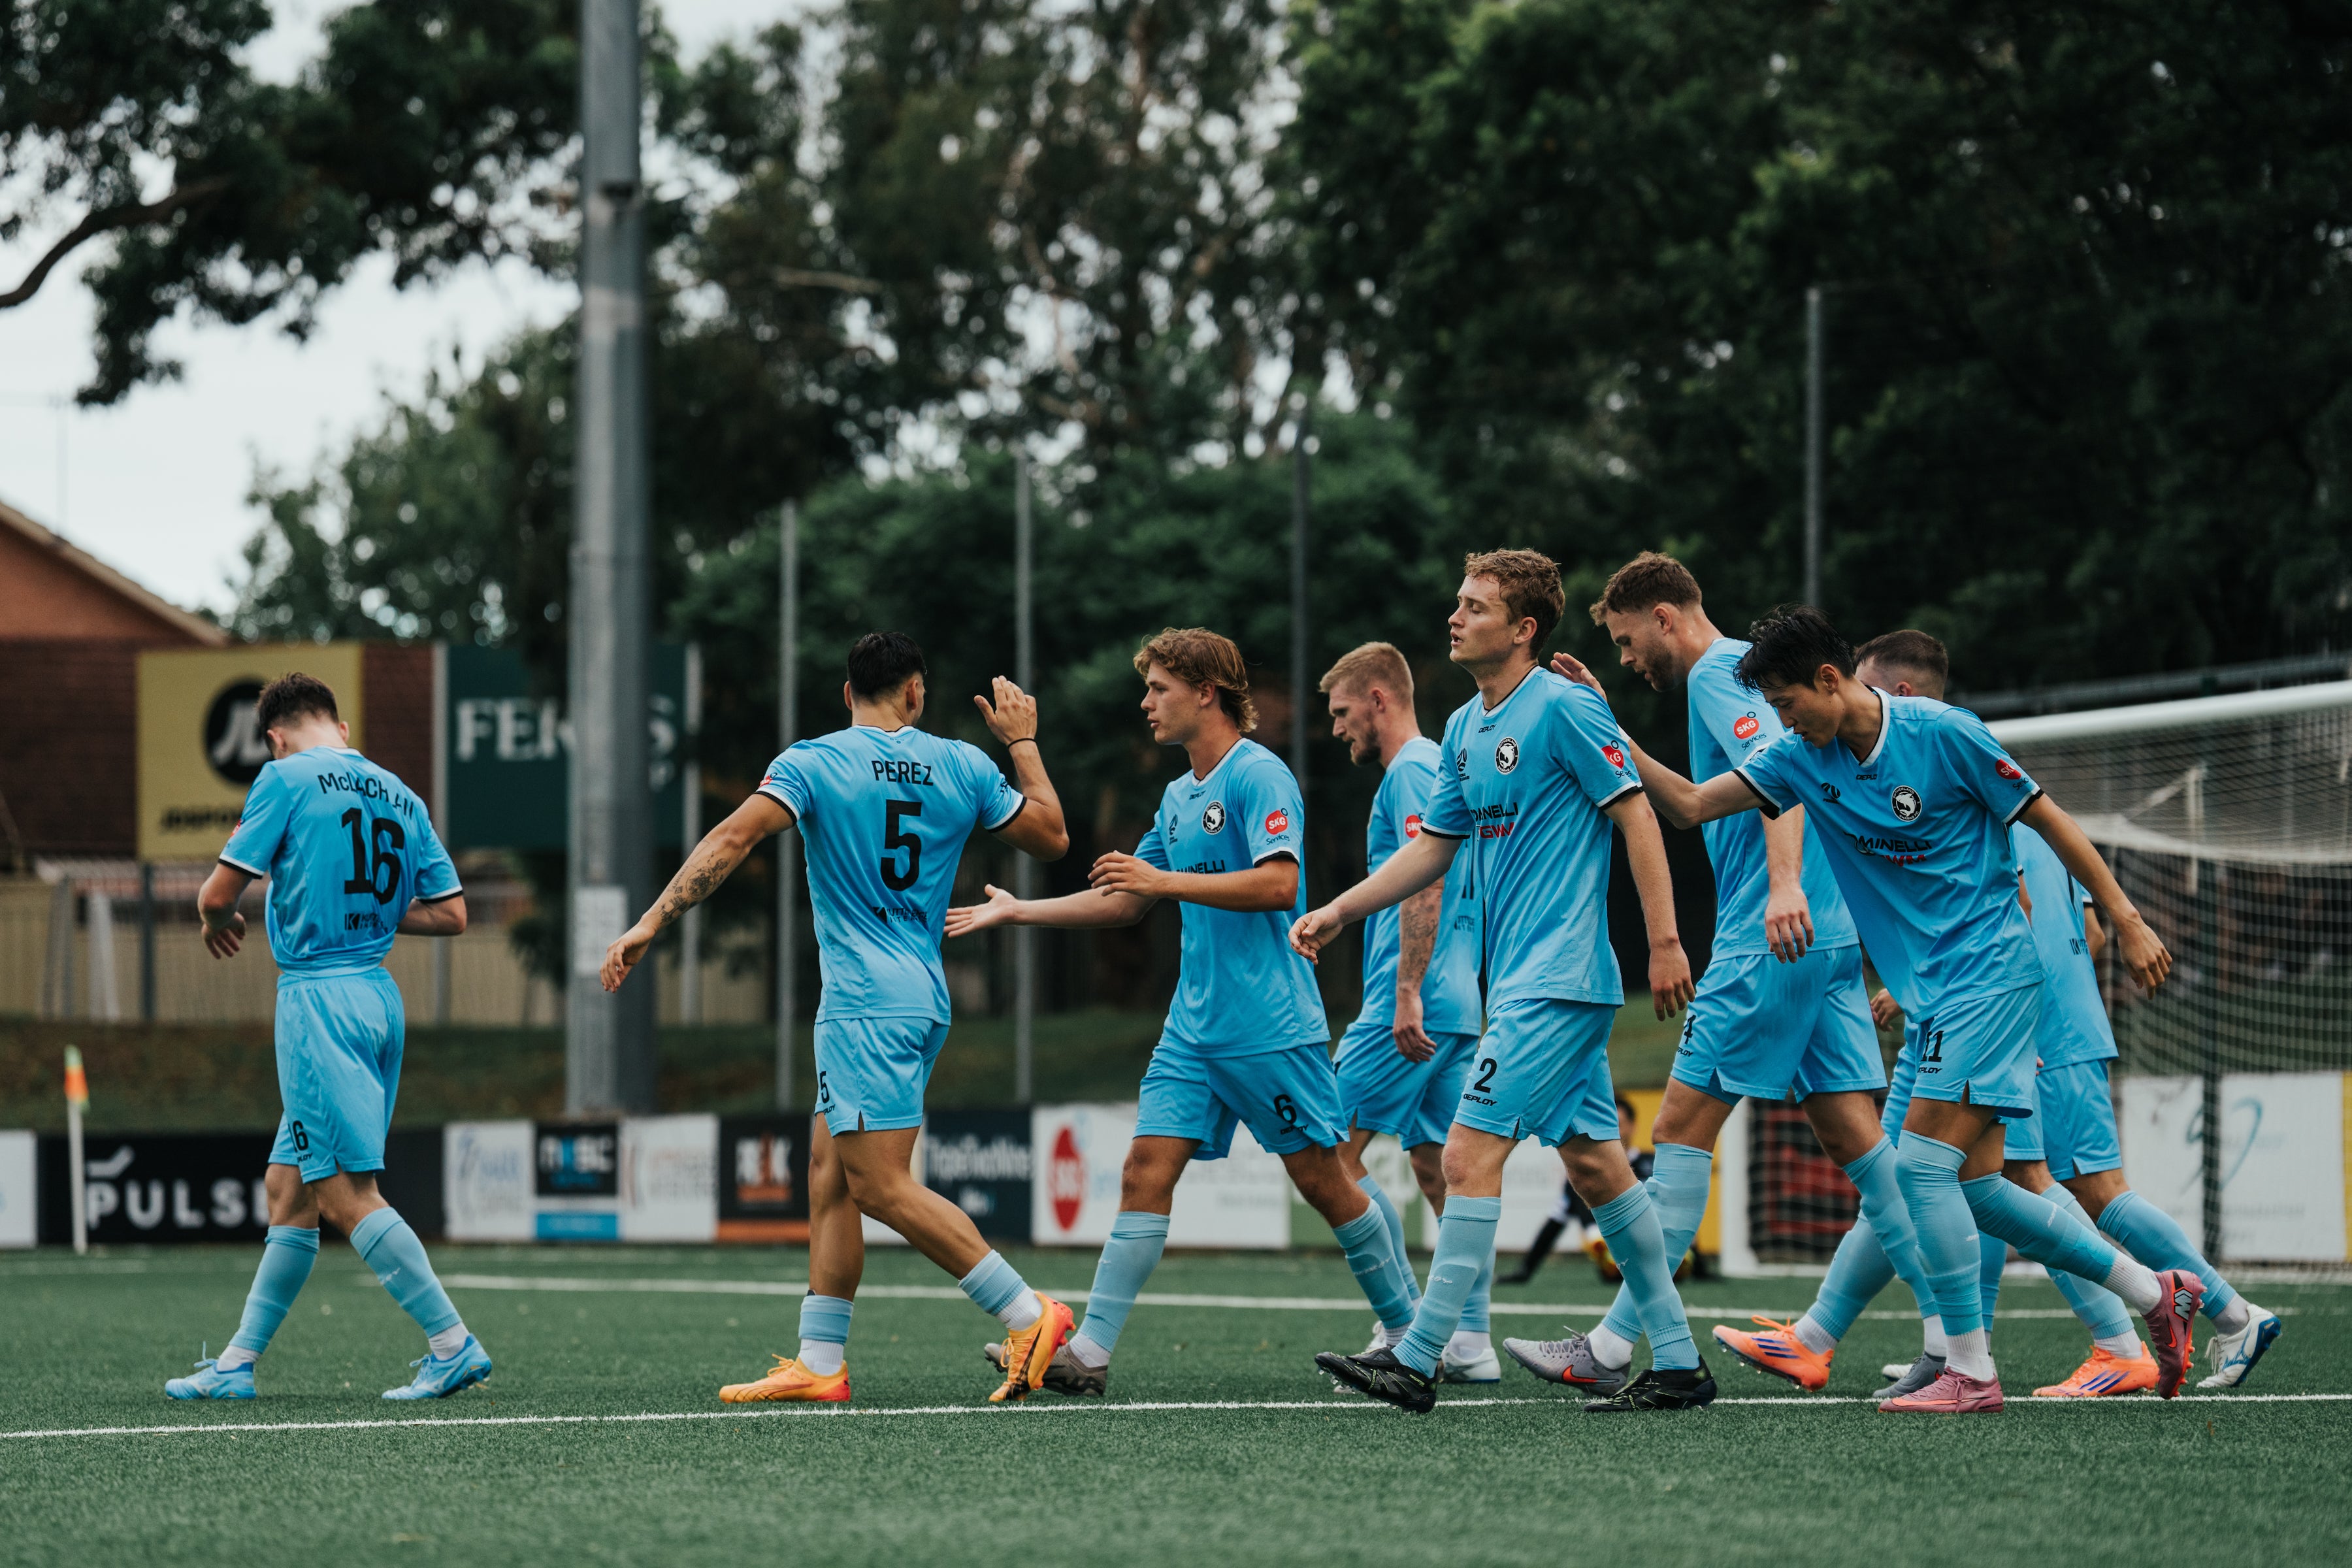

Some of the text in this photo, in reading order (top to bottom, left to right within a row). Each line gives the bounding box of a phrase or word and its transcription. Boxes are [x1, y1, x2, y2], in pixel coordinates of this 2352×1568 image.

[1478, 725, 1497, 733] DEPLOY
[1736, 719, 1756, 735] SKG
[1741, 733, 1767, 751] Services
[871, 760, 934, 786] PEREZ
[1268, 817, 1286, 830] SKG
[880, 799, 922, 892] 5
[1266, 834, 1290, 845] Services
[342, 808, 405, 905] 16
[1919, 1030, 1944, 1062] 11
[819, 1071, 830, 1103] 5
[1473, 1058, 1497, 1094] 2
[1273, 1094, 1297, 1124] 6
[1463, 1093, 1498, 1106] DEPLOY
